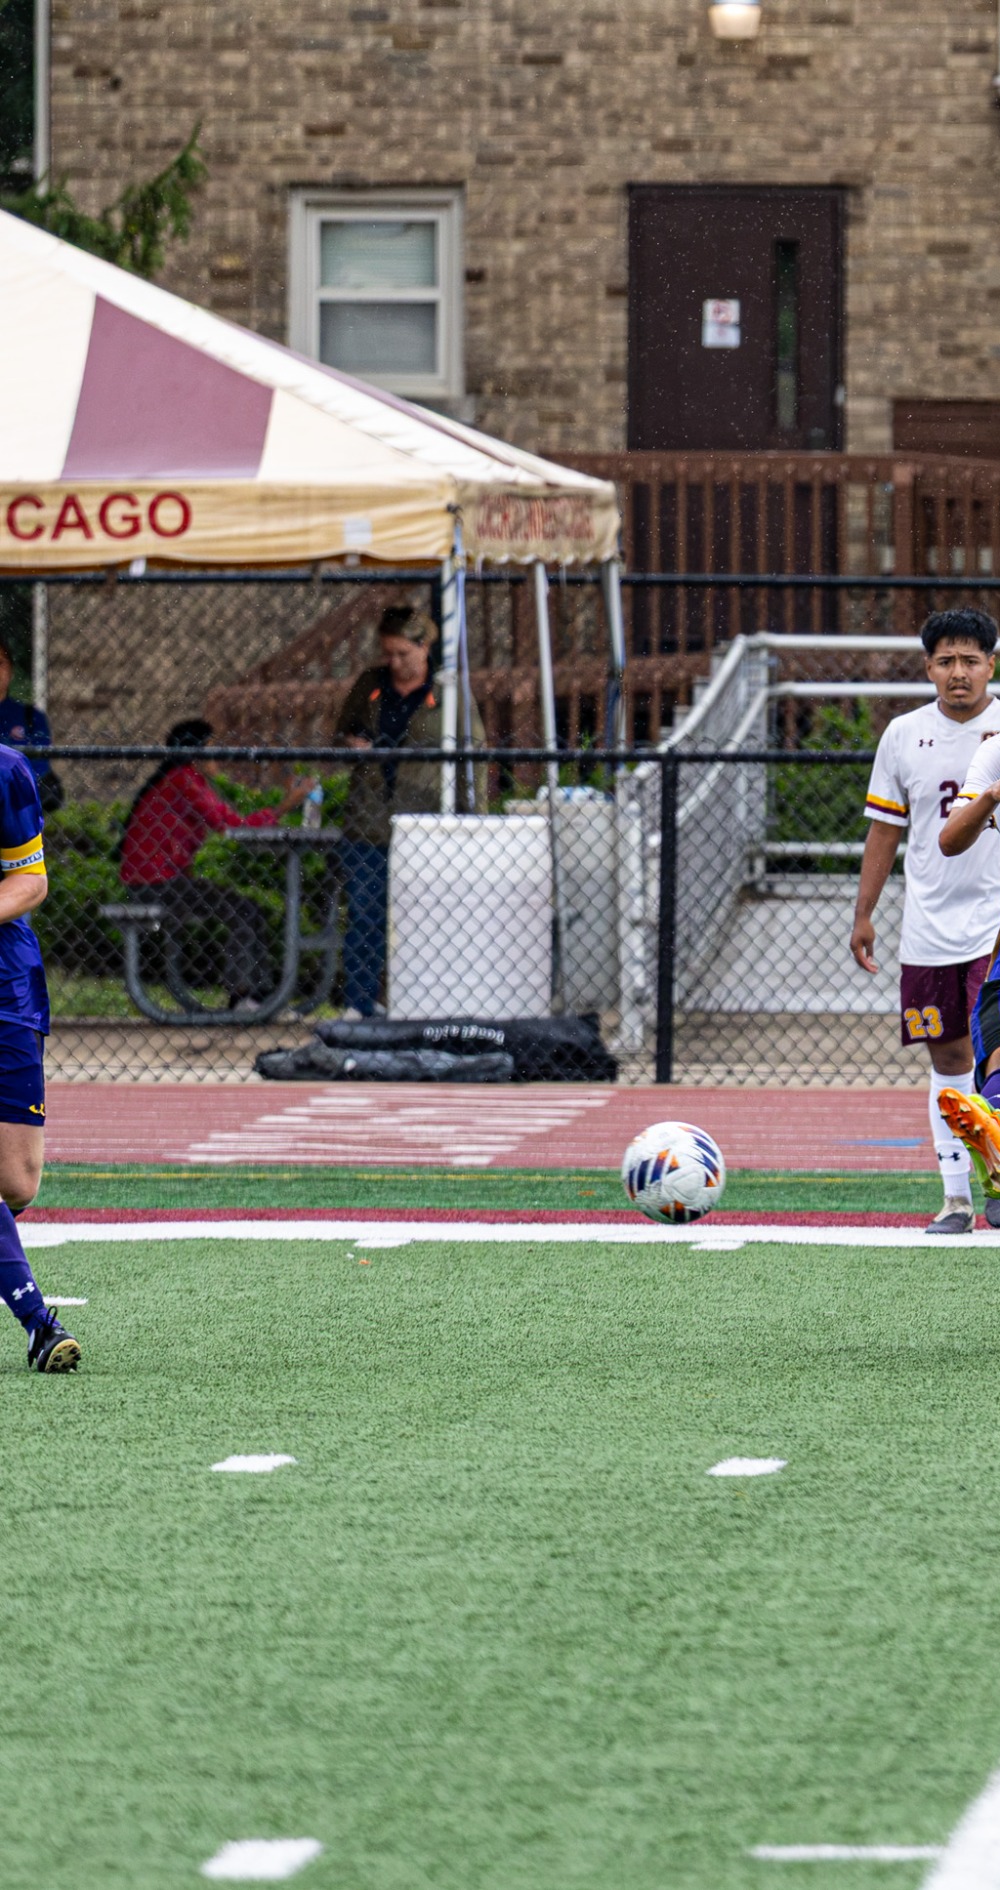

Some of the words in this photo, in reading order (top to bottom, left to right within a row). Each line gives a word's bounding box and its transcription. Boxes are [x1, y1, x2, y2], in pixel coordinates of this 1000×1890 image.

[6, 490, 192, 541] CAGO
[939, 780, 964, 818] 2
[904, 1005, 944, 1039] 23
